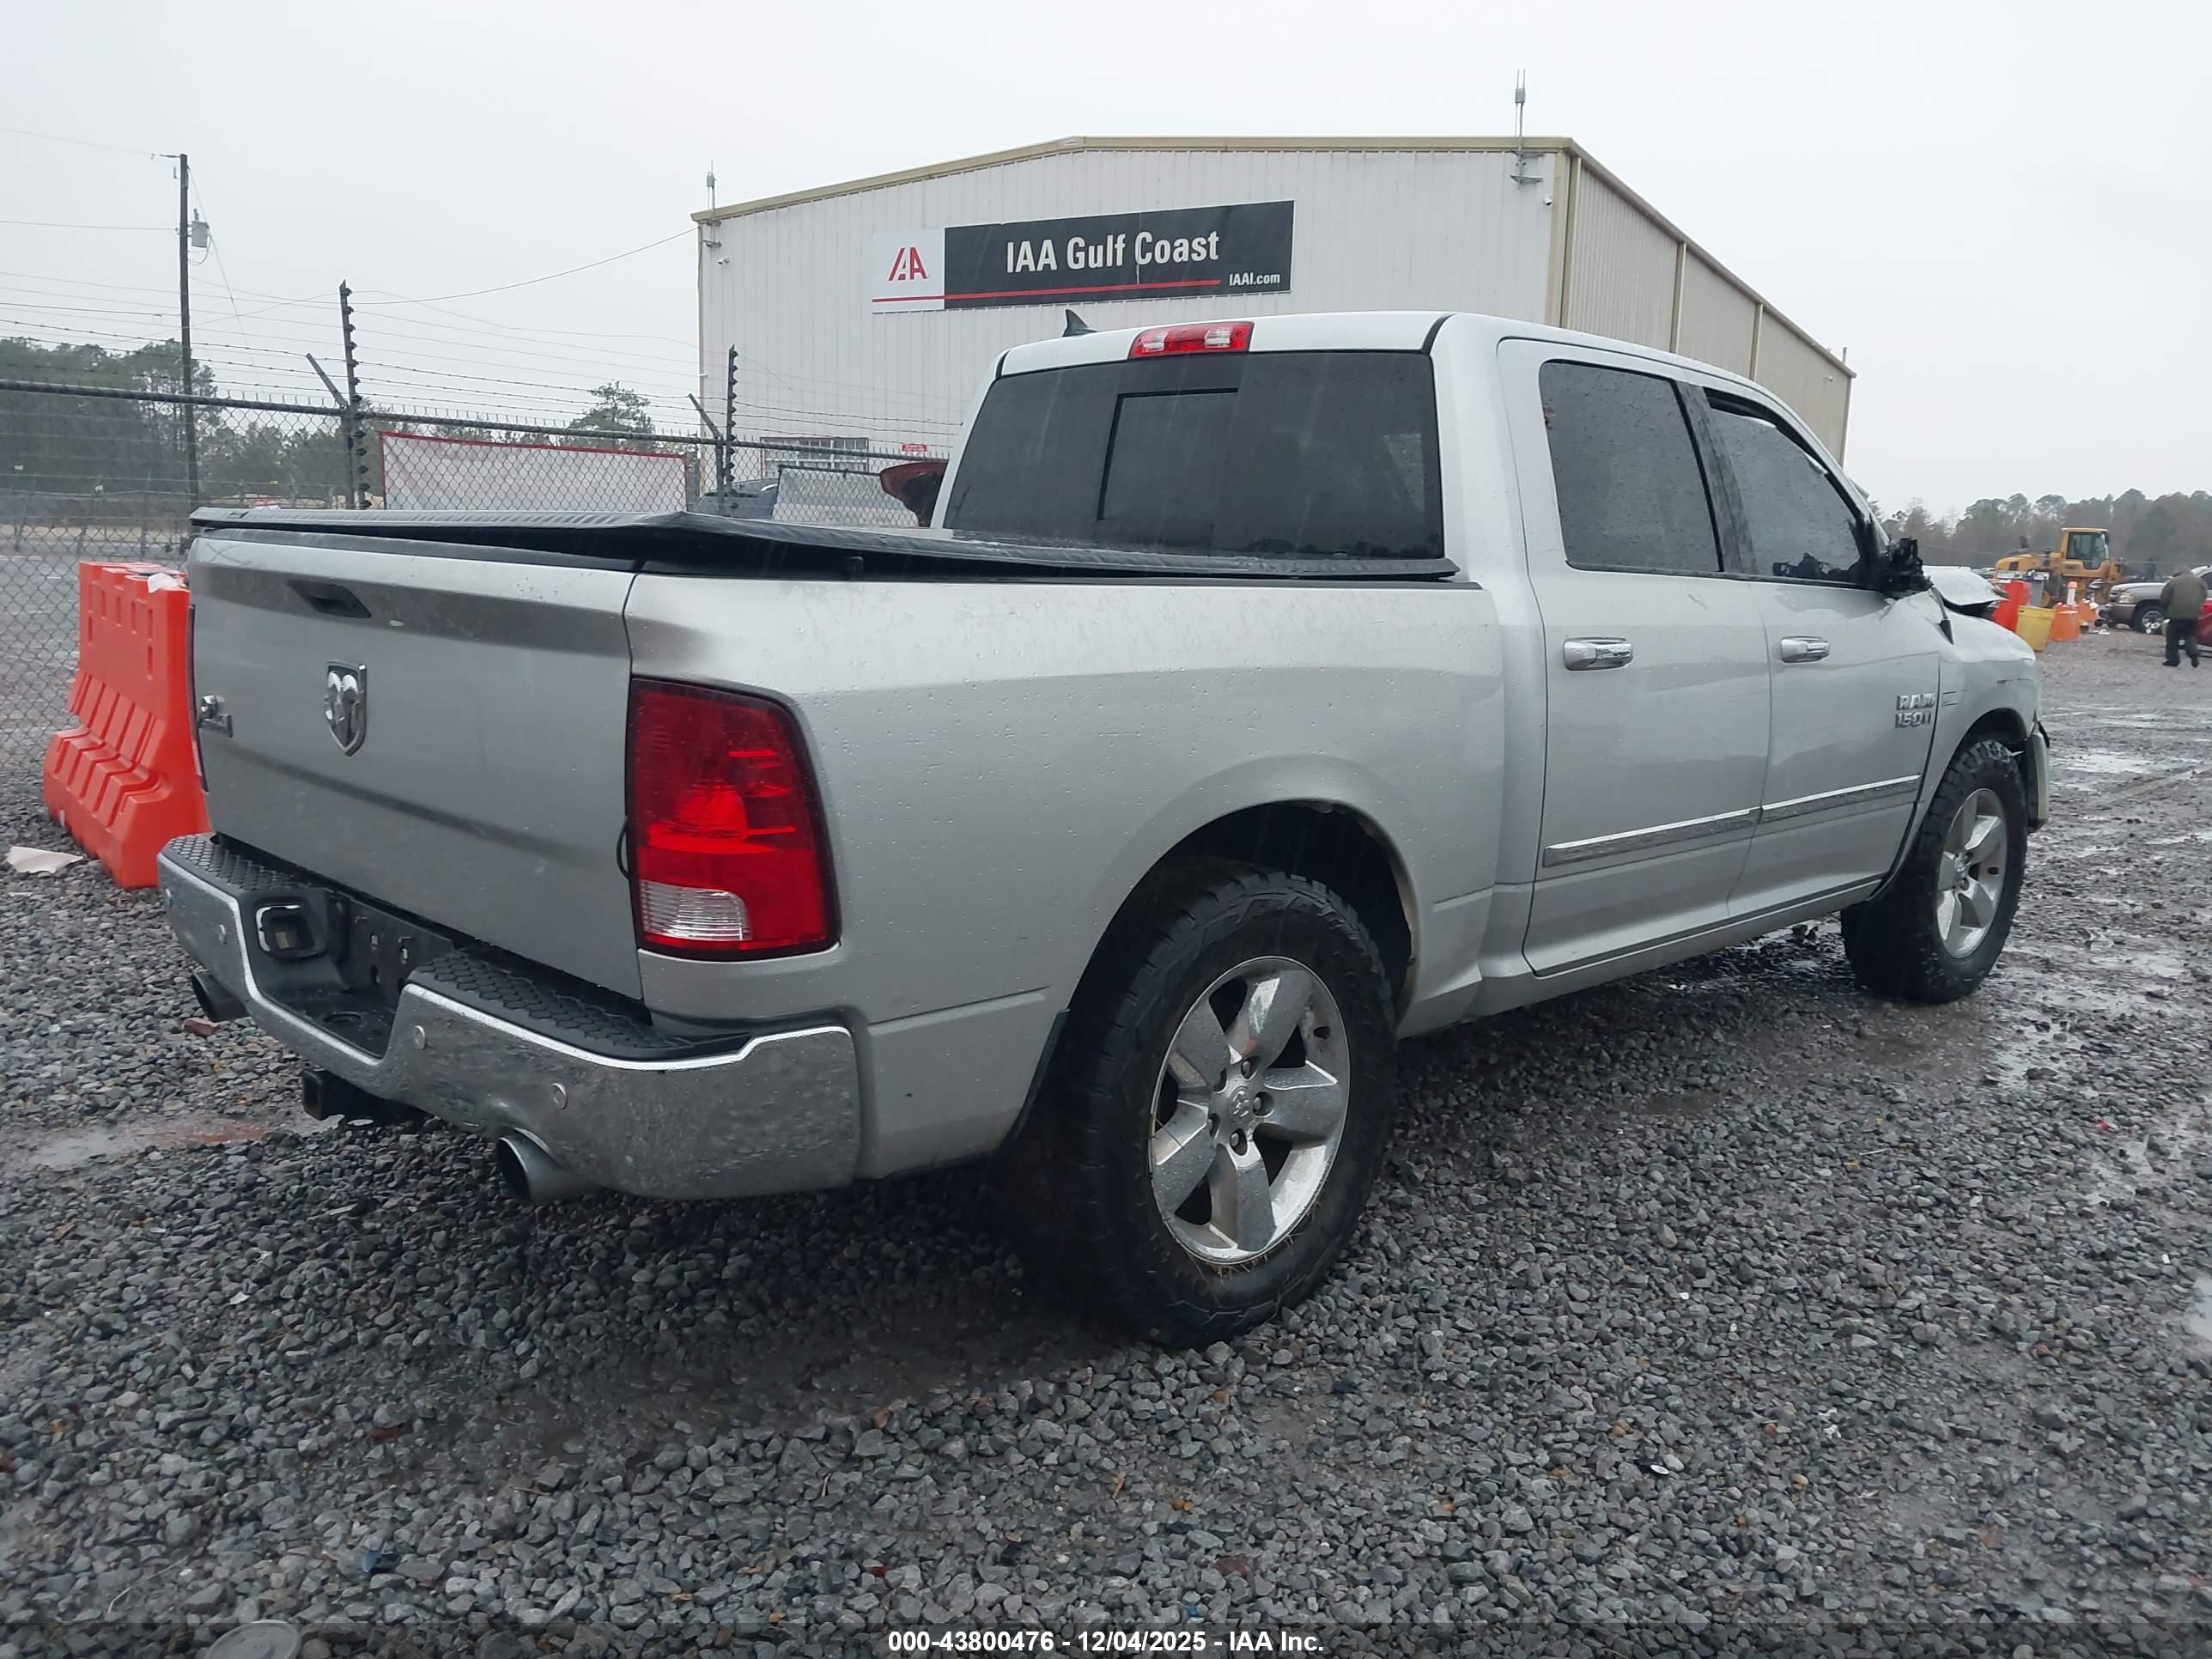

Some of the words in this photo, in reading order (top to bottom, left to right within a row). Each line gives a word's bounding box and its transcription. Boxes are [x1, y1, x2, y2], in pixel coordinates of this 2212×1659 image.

[1006, 239, 1058, 273] IAA
[1066, 234, 1126, 270] Gulf
[1134, 230, 1219, 265] Coast
[1229, 271, 1280, 286] IAAI.com
